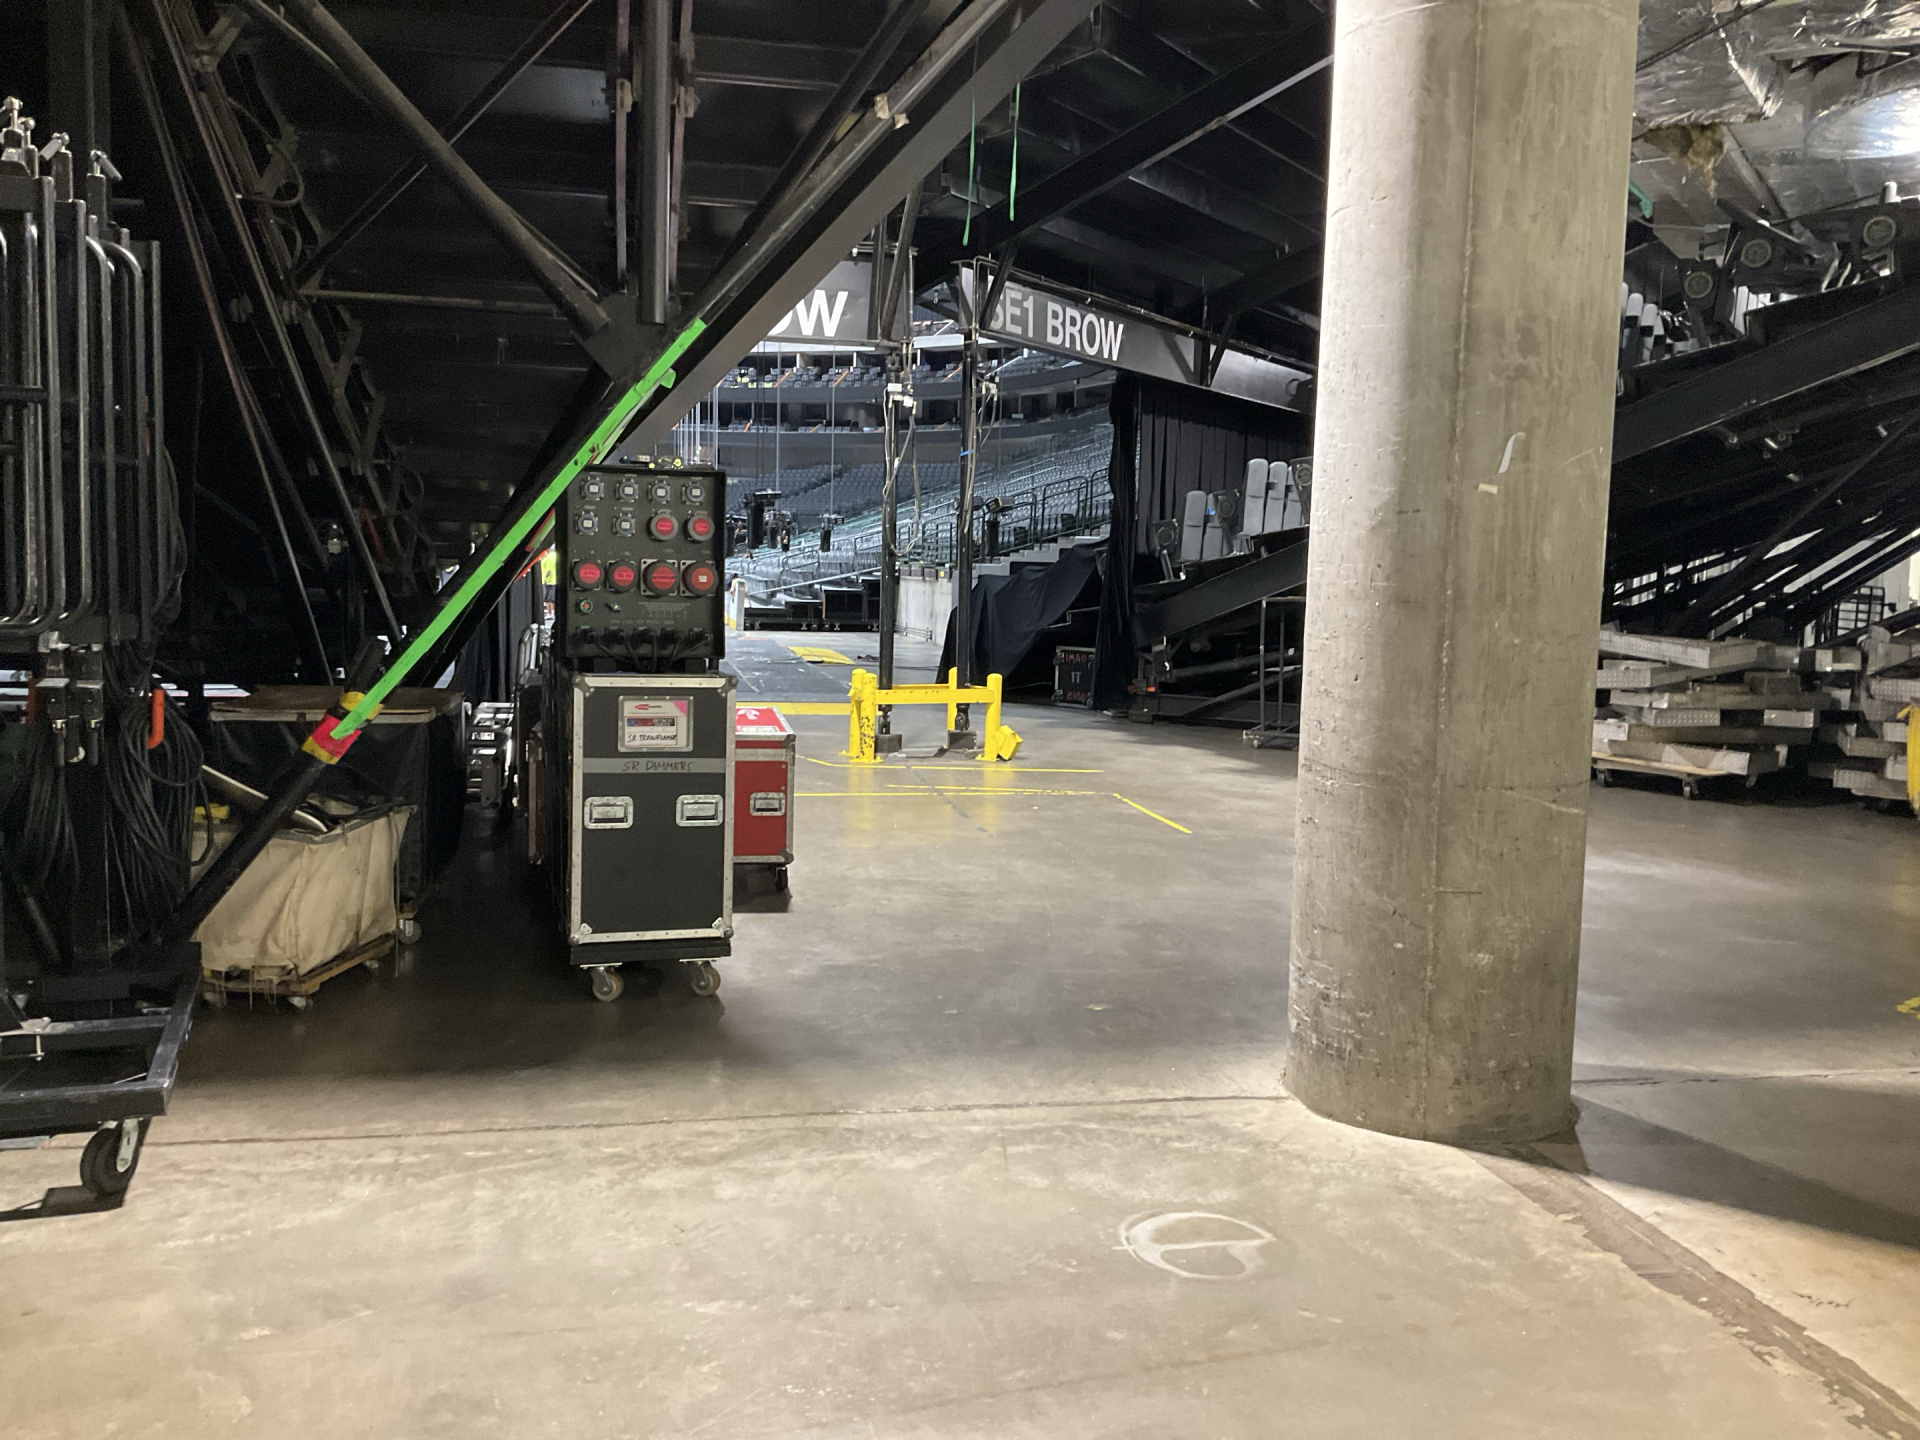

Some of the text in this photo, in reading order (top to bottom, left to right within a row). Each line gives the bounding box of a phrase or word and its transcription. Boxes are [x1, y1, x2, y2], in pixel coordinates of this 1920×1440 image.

[767, 289, 849, 337] W
[1047, 301, 1124, 361] BROW
[622, 760, 694, 772] SR DIMMERS
